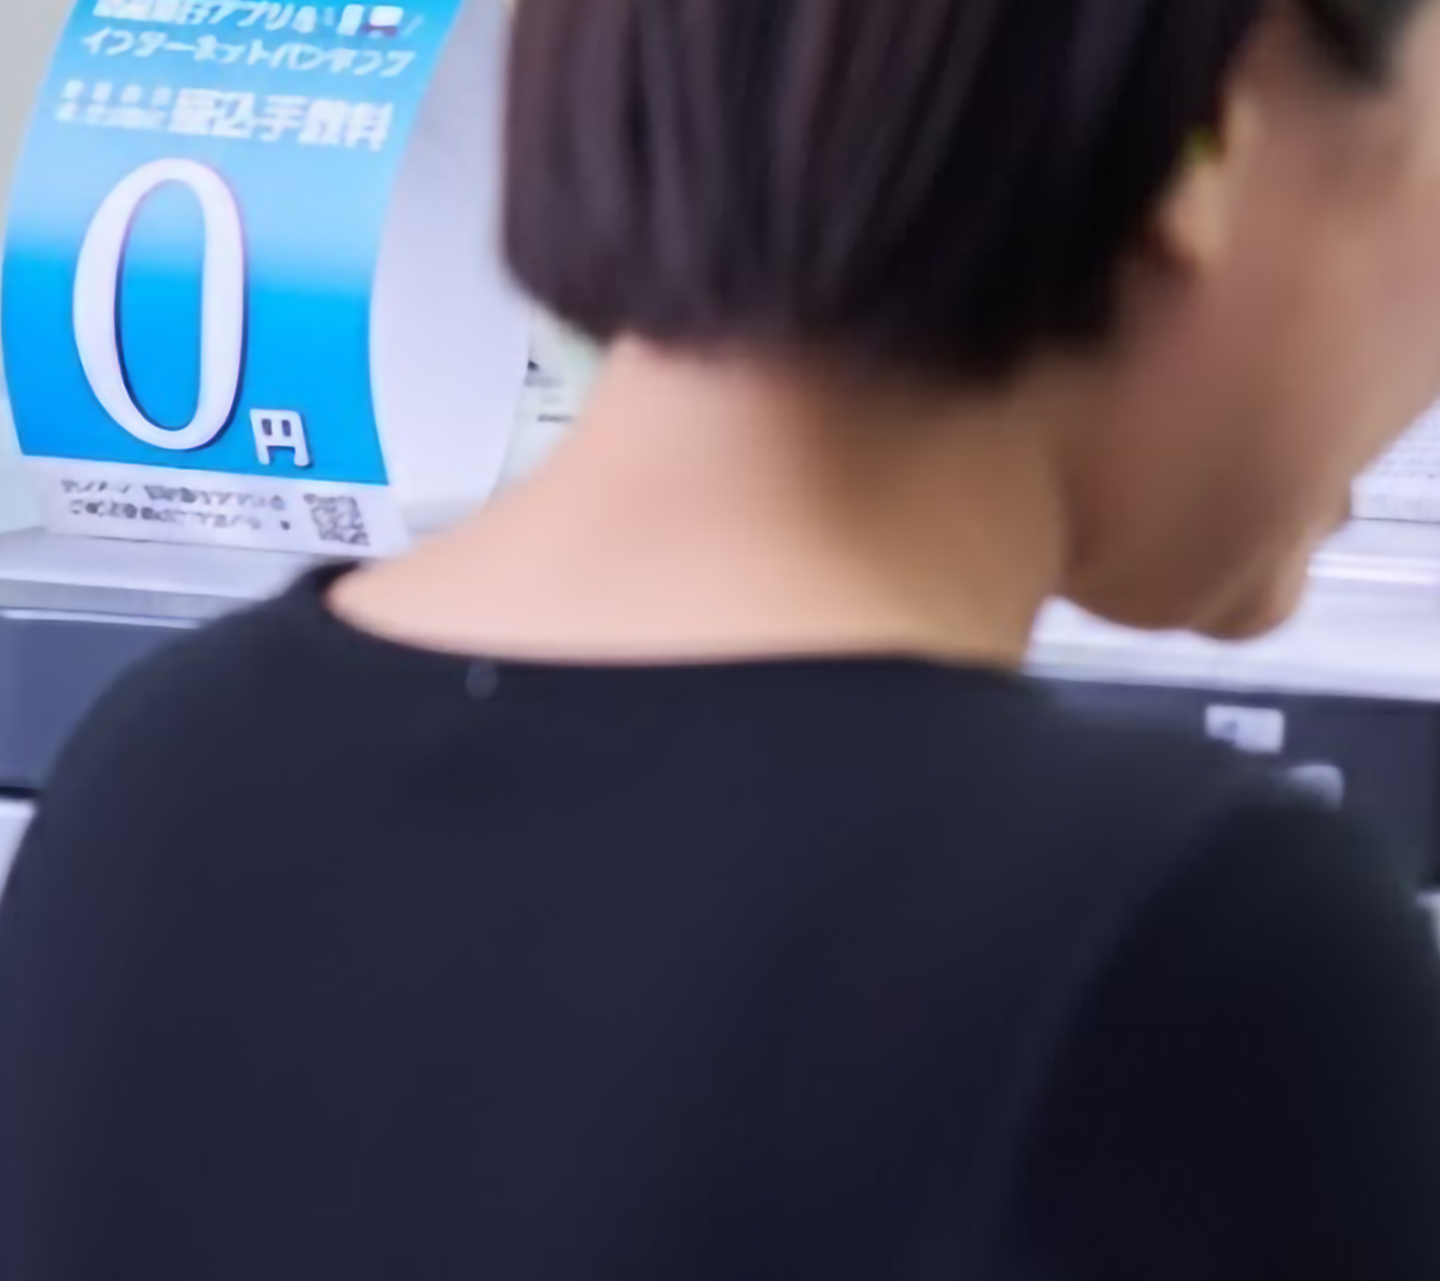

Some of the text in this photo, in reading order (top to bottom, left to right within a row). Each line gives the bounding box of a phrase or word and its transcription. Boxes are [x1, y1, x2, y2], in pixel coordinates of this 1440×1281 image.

[82, 26, 418, 78] インターネットバンキング
